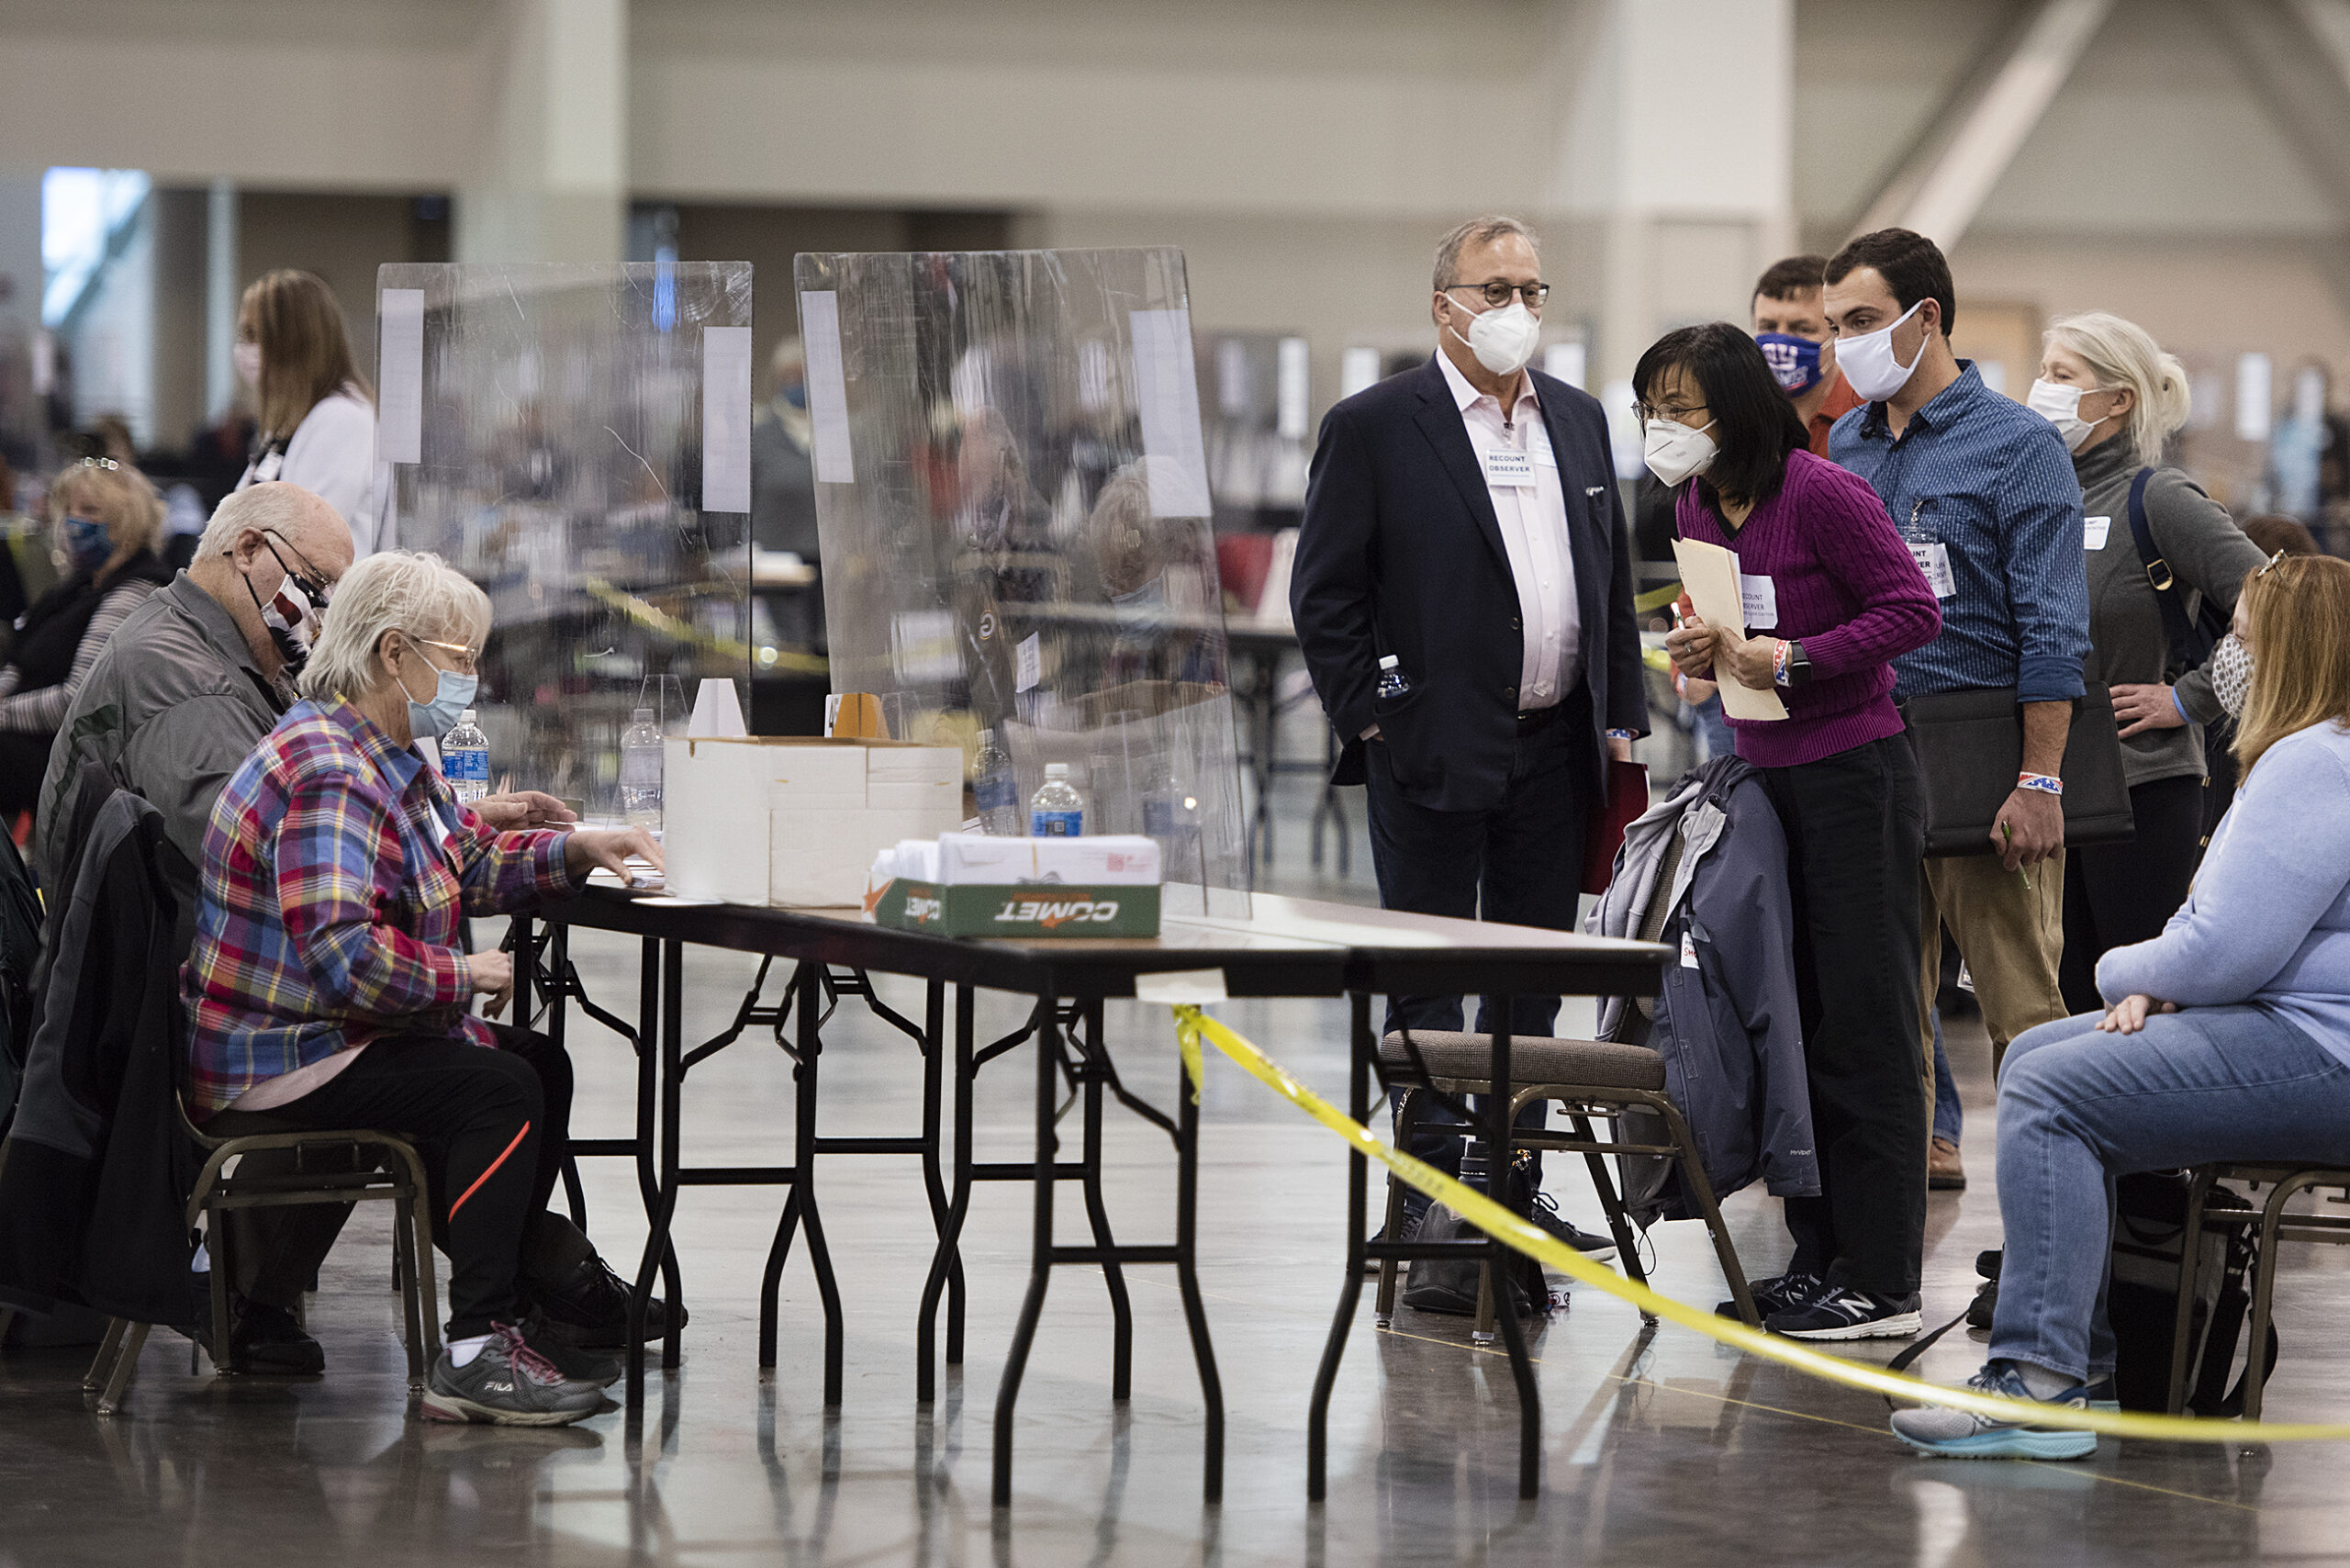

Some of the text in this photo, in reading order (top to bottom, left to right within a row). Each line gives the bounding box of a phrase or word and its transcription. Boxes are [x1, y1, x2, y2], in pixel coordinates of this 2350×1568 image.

[905, 897, 941, 920] COMET
[994, 901, 1119, 922] COMET
[484, 1382, 514, 1392] FILA
